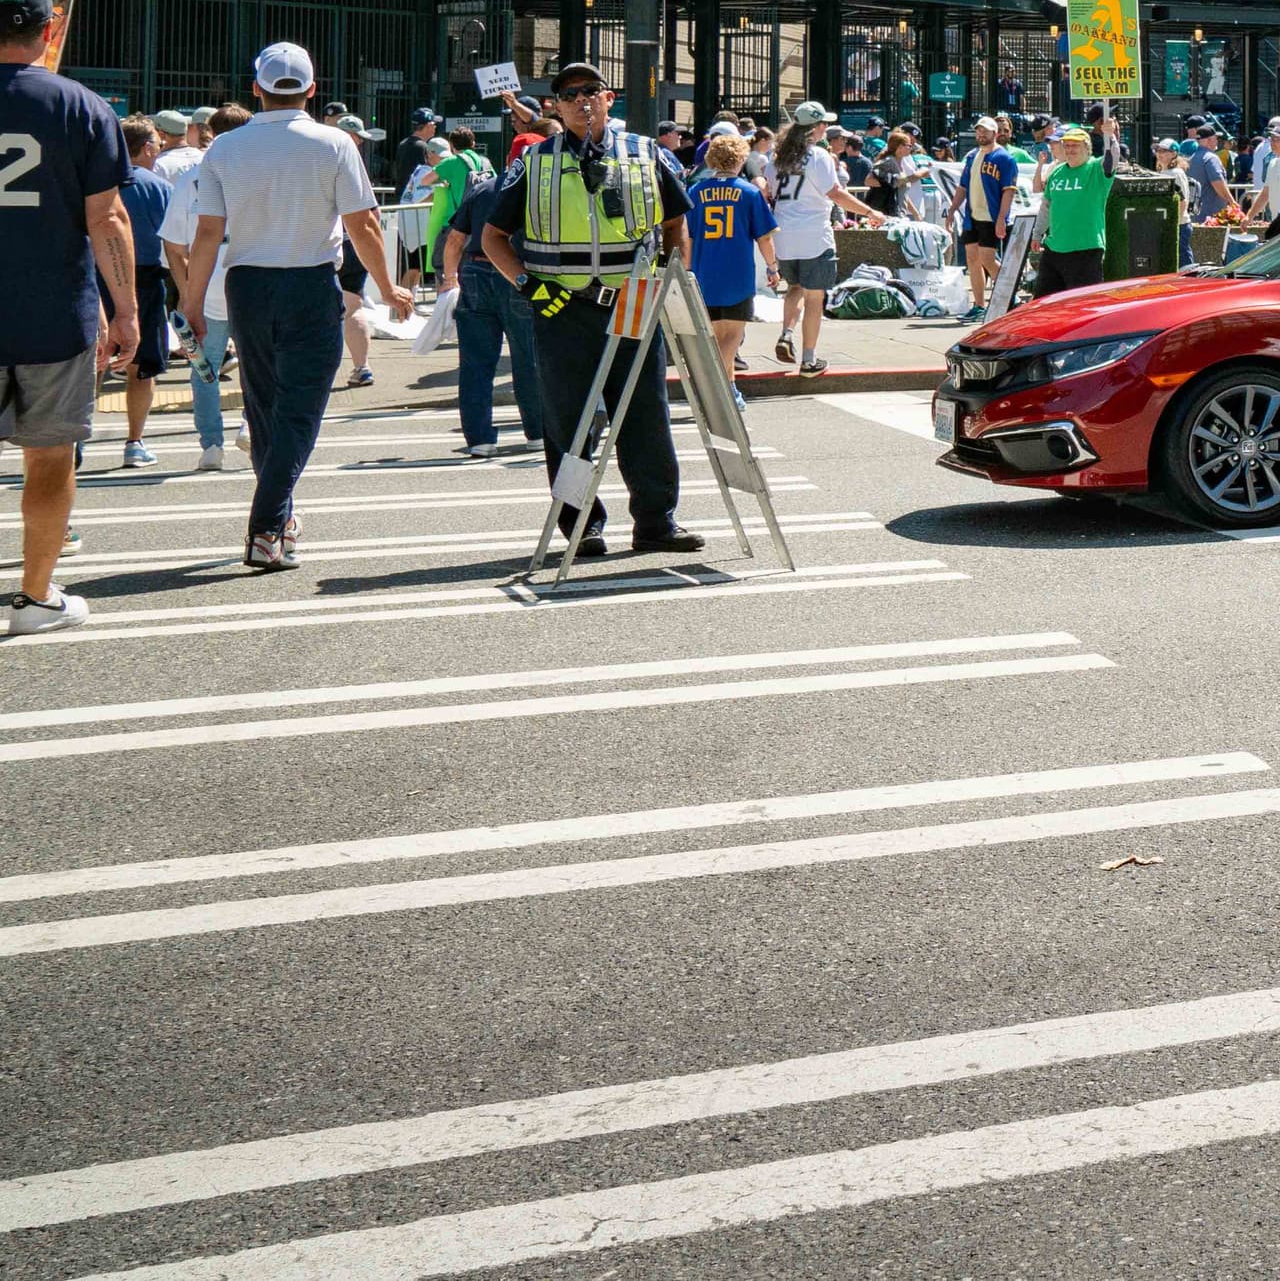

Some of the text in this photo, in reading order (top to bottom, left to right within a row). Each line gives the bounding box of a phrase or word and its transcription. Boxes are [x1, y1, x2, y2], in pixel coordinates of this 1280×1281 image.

[1075, 67, 1136, 80] SELL THE
[483, 83, 519, 96] TICKETS
[1083, 81, 1129, 95] TEAM
[1050, 178, 1083, 191] SELL
[699, 186, 742, 203] ICHIRO
[704, 205, 734, 239] 51
